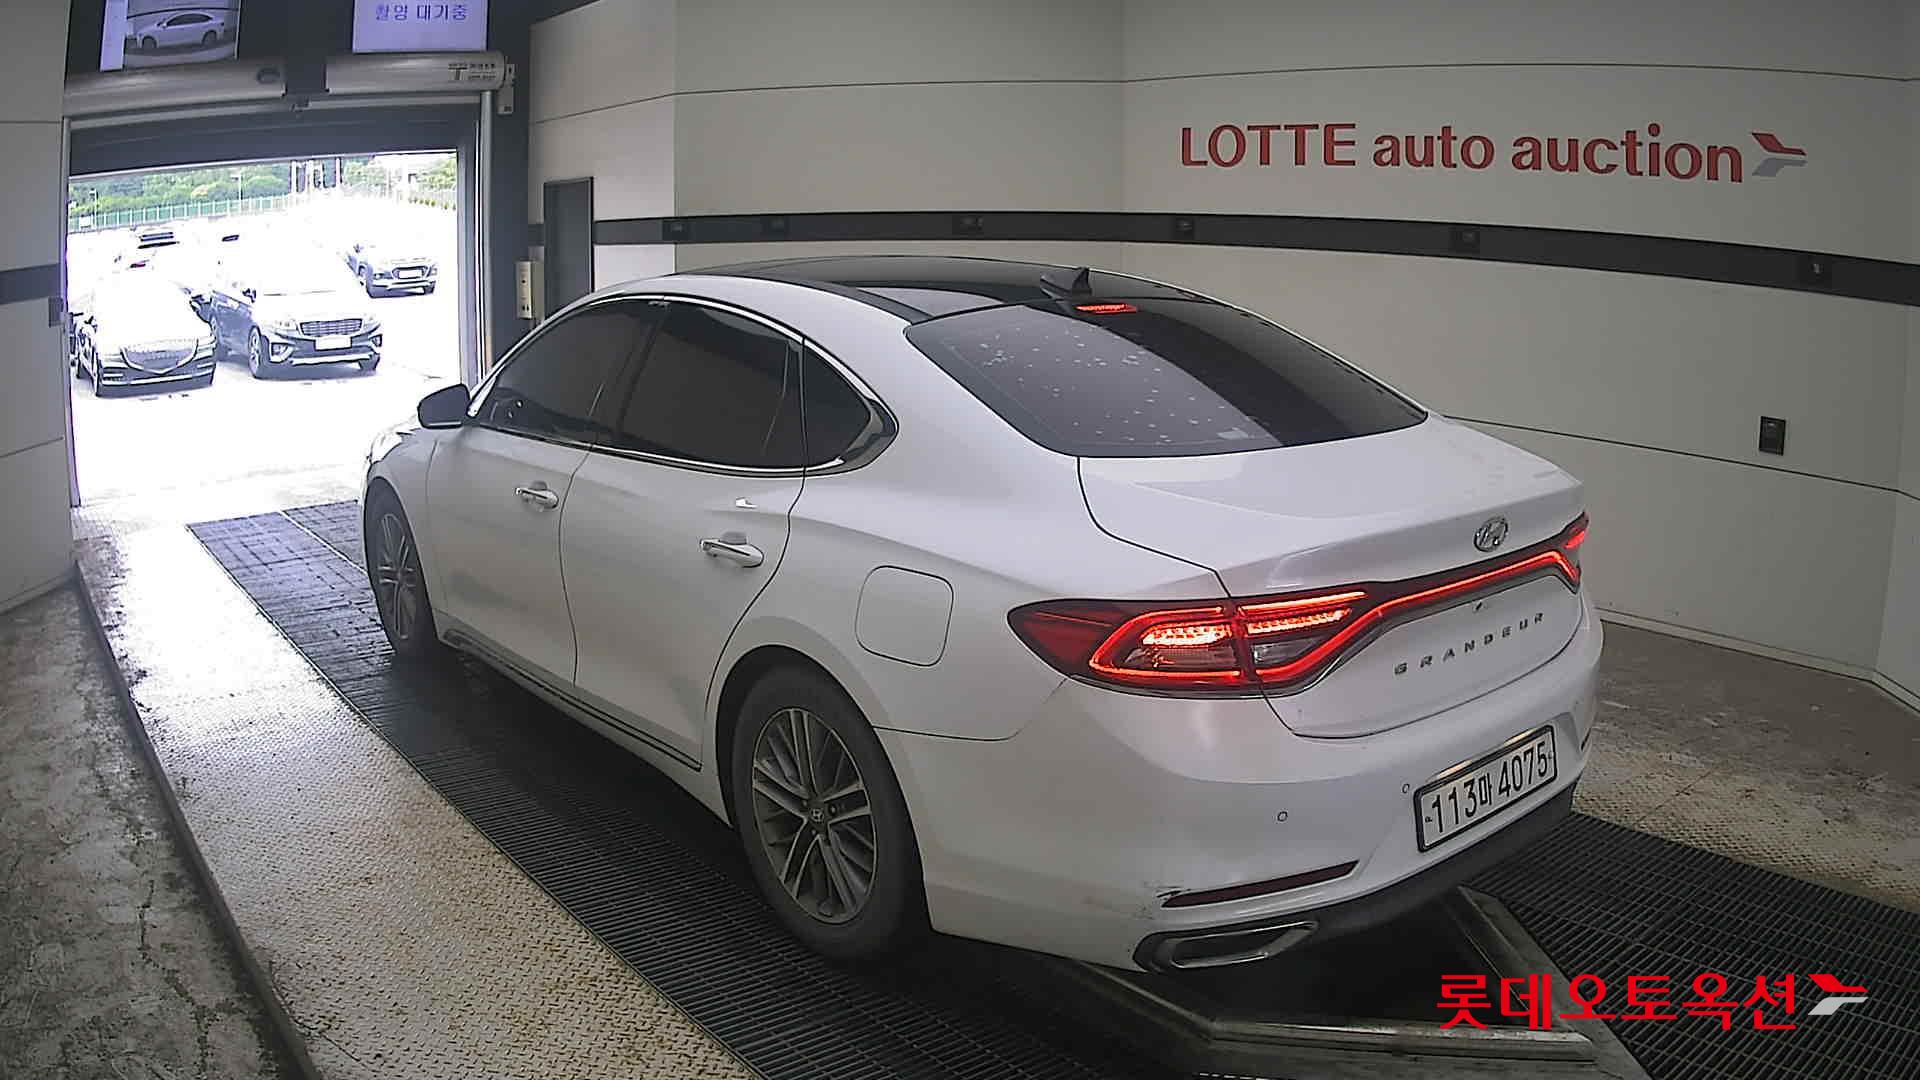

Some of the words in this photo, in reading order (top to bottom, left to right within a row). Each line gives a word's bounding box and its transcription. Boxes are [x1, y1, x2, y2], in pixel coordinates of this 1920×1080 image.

[416, 4, 467, 21] 대기중
[1182, 124, 1355, 167] LOTTE
[1373, 125, 1495, 168] auto
[1512, 122, 1743, 182] auction
[1394, 612, 1544, 675] GRANDEUR
[1431, 771, 1493, 833] 113마
[1498, 740, 1549, 798] 4075
